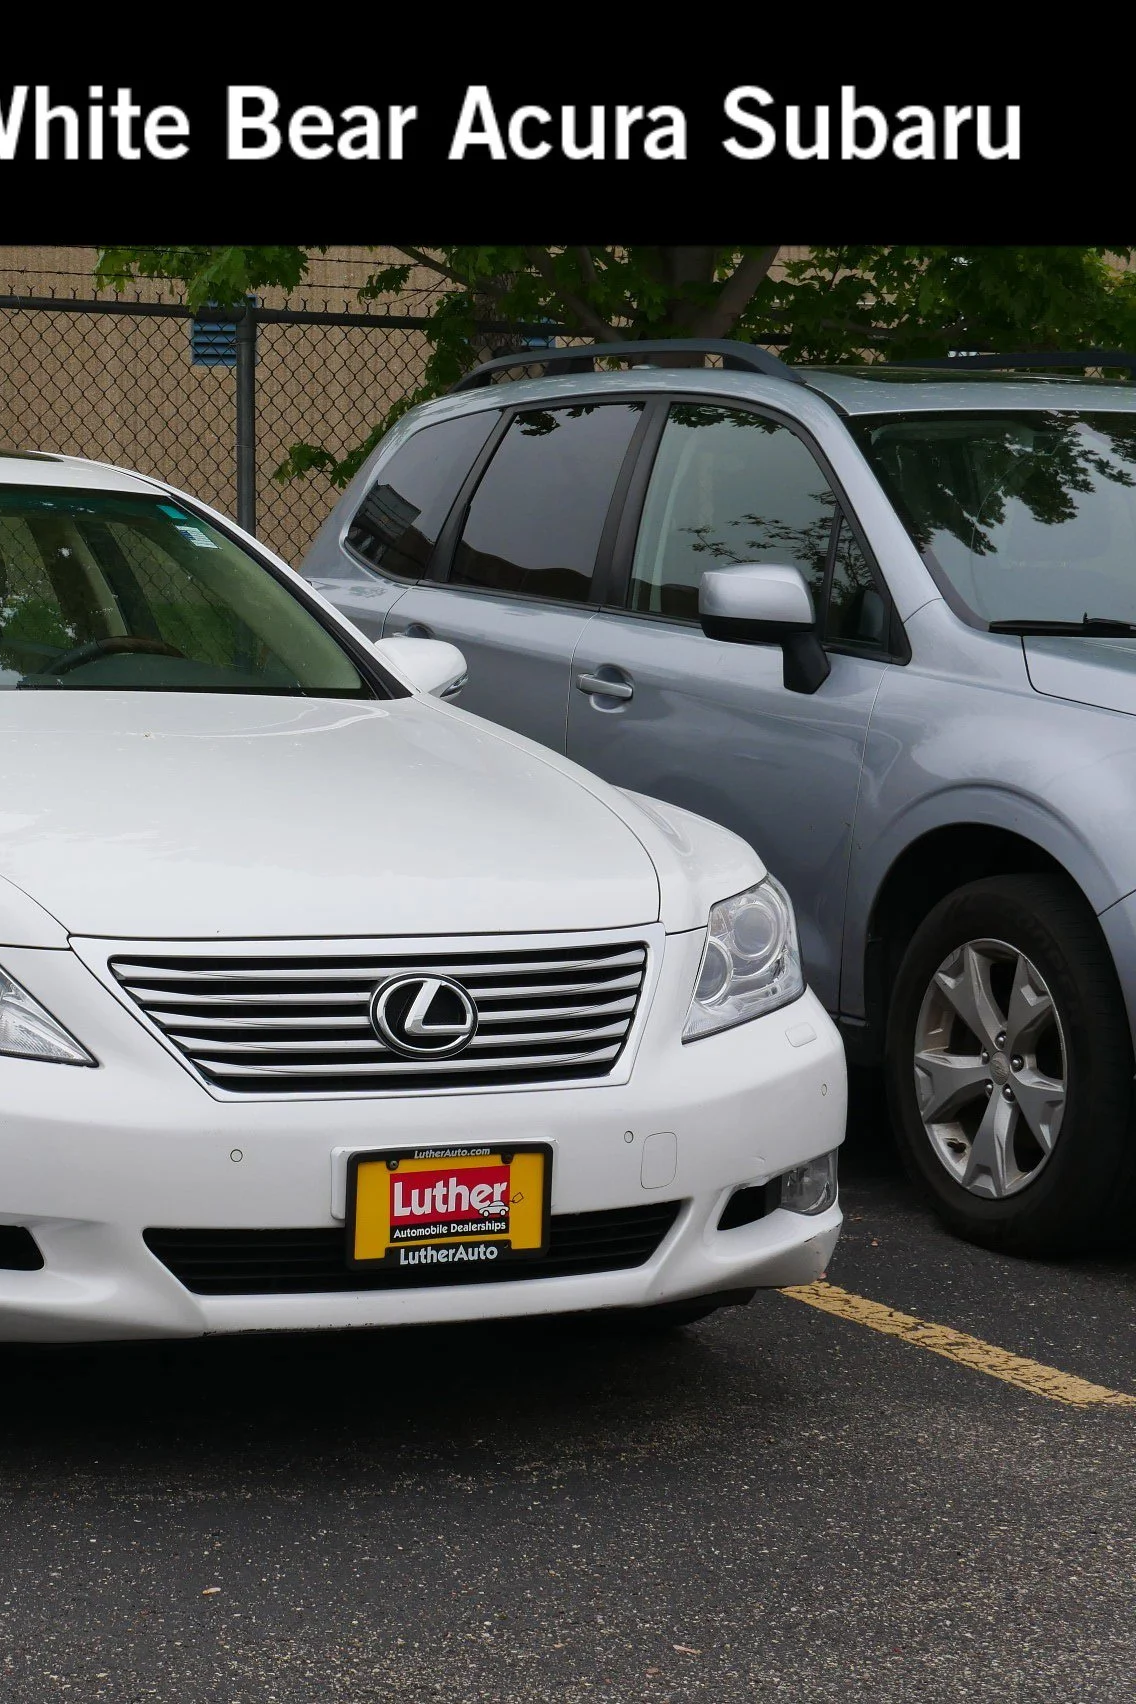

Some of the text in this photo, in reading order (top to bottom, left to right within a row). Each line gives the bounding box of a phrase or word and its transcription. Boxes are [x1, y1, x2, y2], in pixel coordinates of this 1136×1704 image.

[414, 1147, 491, 1160] LutherAuto.com
[393, 1177, 507, 1217] Luther
[393, 1221, 506, 1239] Automobile Dealerships
[399, 1244, 498, 1266] LutherAuto
